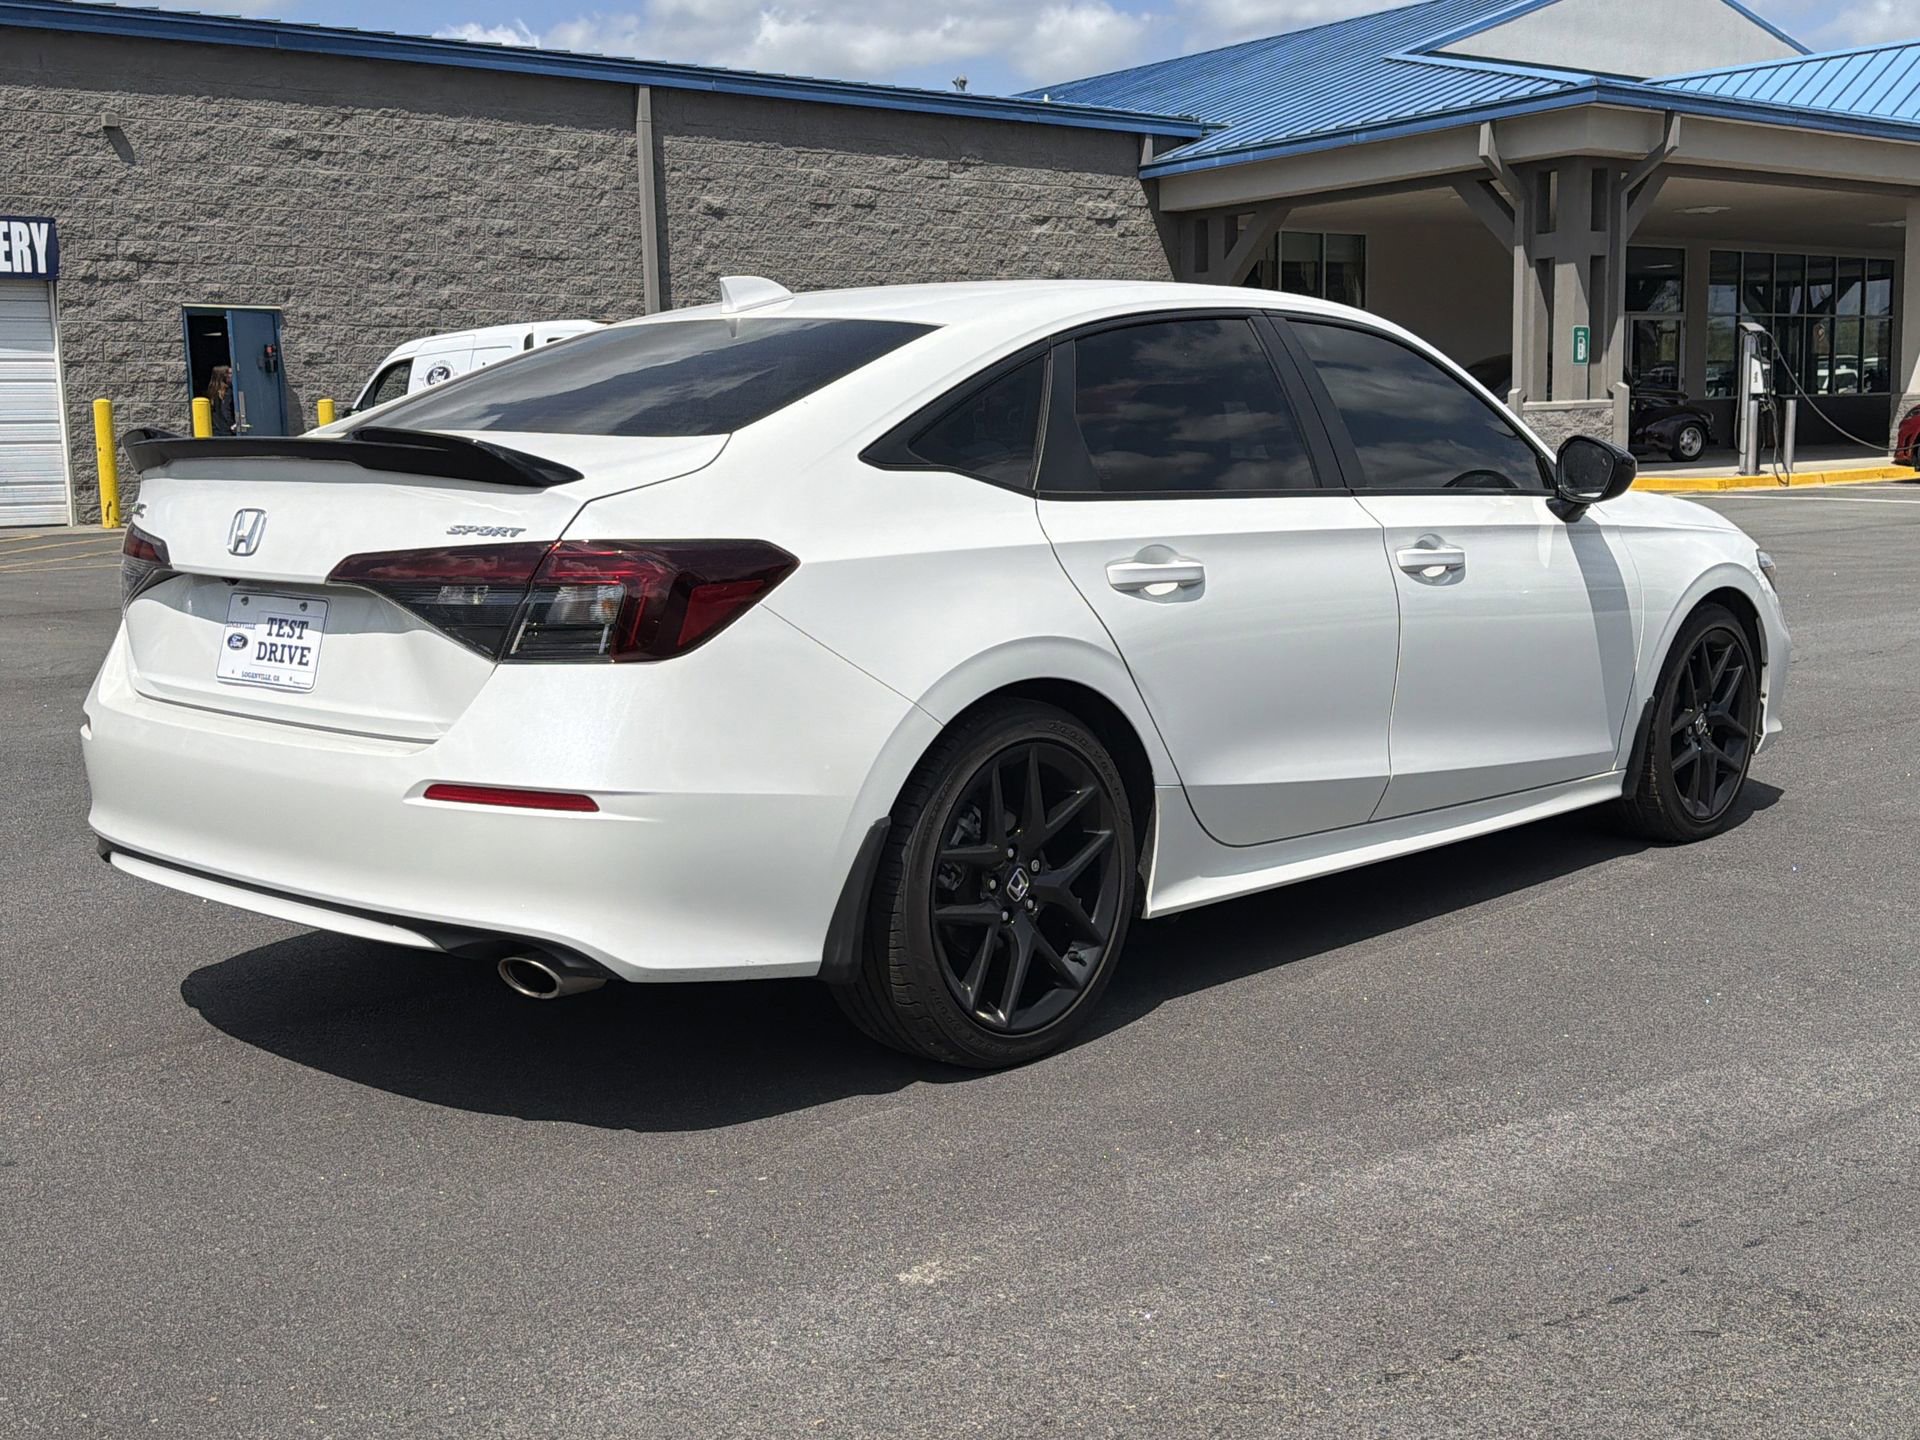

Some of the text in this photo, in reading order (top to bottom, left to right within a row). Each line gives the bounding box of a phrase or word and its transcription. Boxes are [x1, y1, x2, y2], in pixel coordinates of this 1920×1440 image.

[446, 525, 527, 537] SPORT
[267, 617, 309, 639] TEST
[256, 641, 311, 666] DRIVE
